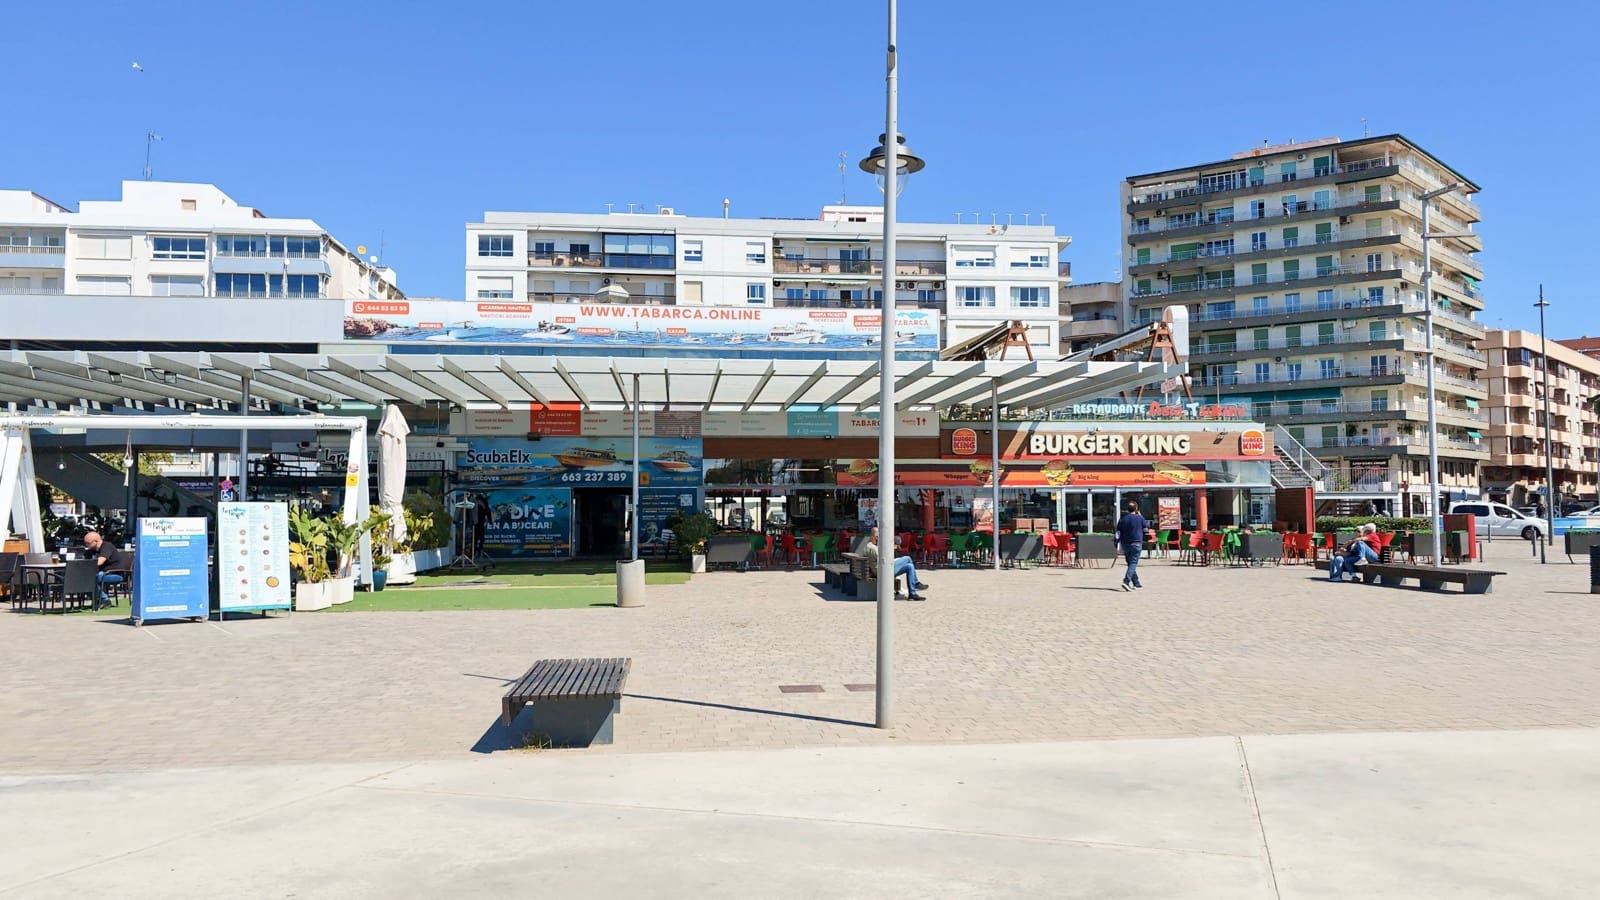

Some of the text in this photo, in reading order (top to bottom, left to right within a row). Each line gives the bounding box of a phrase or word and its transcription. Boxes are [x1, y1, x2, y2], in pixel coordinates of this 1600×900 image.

[580, 306, 761, 320] WWW.TABARCA.ONLINE
[1073, 404, 1145, 414] RESTAURANTE
[916, 417, 920, 426] 1
[1030, 434, 1190, 455] BURGER KING
[467, 450, 530, 464] ScubaElx
[562, 472, 627, 482] 663 237 389
[510, 504, 554, 519] DIVE
